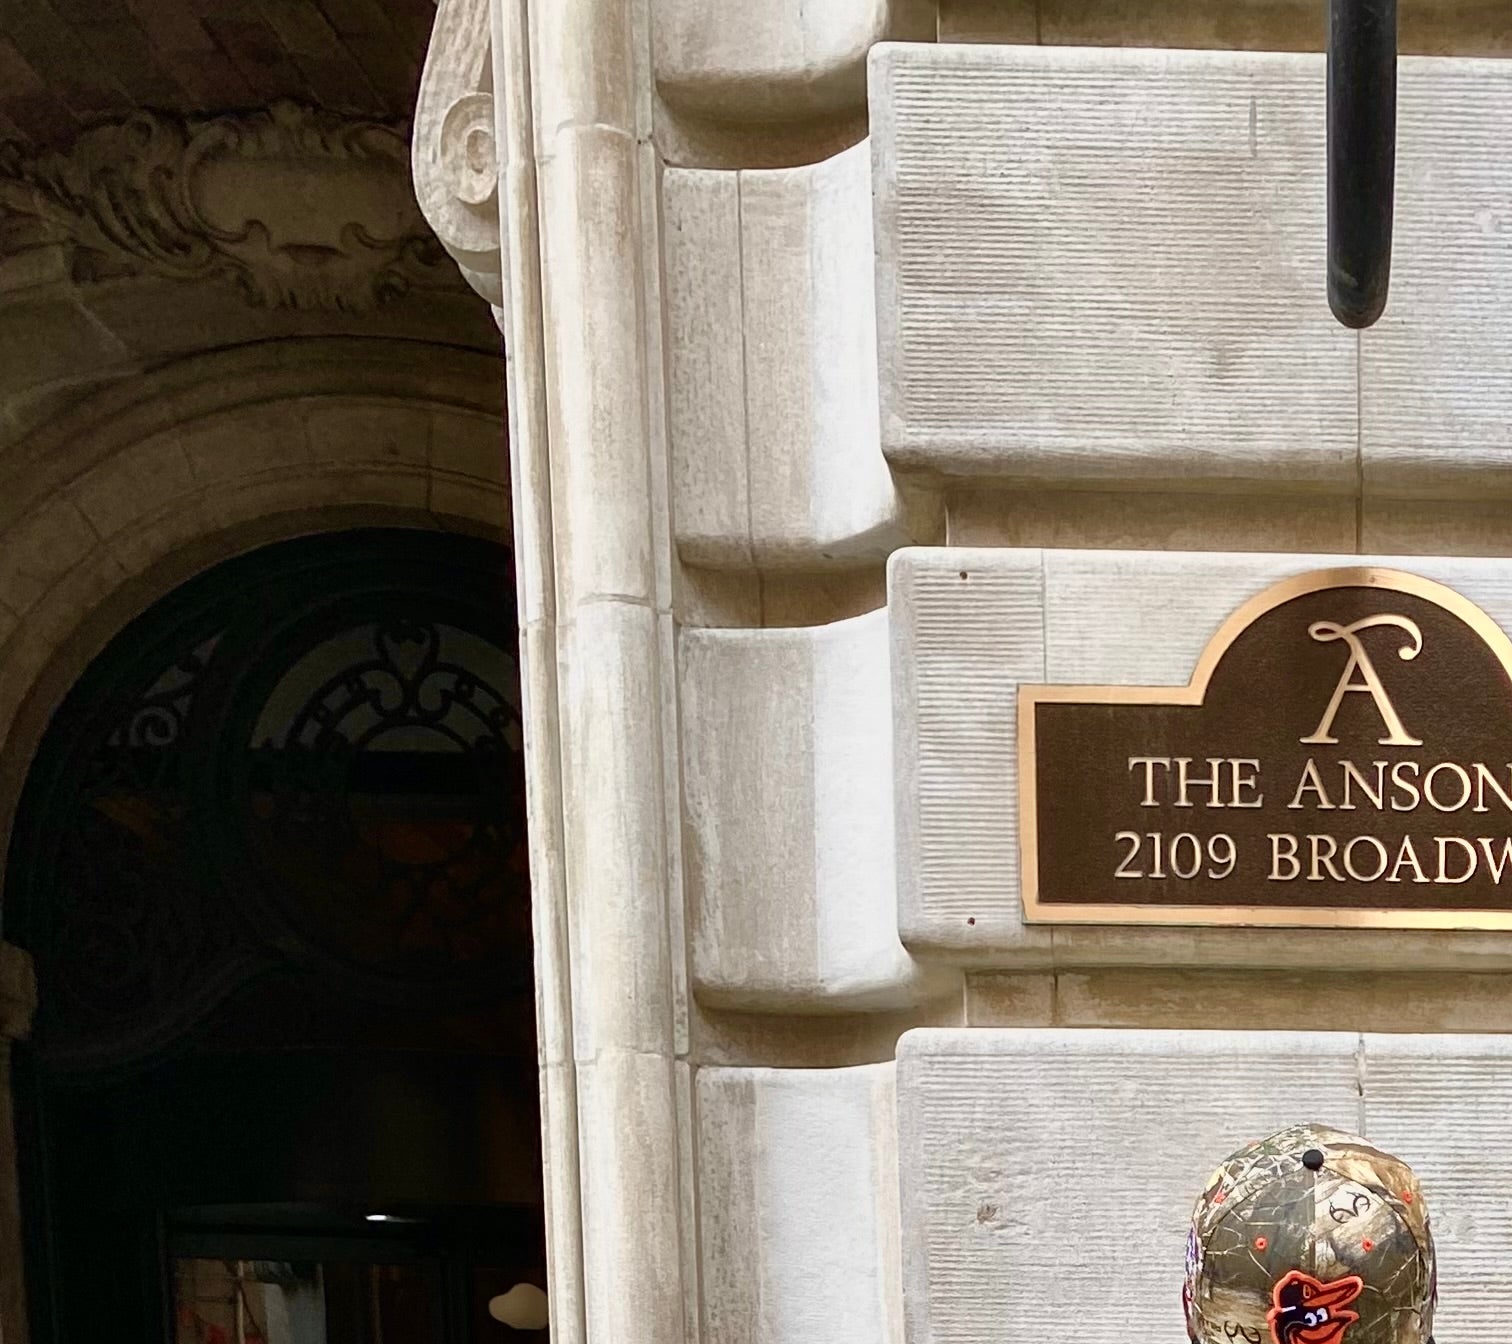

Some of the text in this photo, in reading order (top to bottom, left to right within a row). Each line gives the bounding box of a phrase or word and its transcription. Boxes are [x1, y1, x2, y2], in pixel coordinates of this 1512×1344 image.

[1300, 613, 1424, 747] A
[1128, 756, 1264, 808] THE
[1113, 830, 1238, 881] 2109
